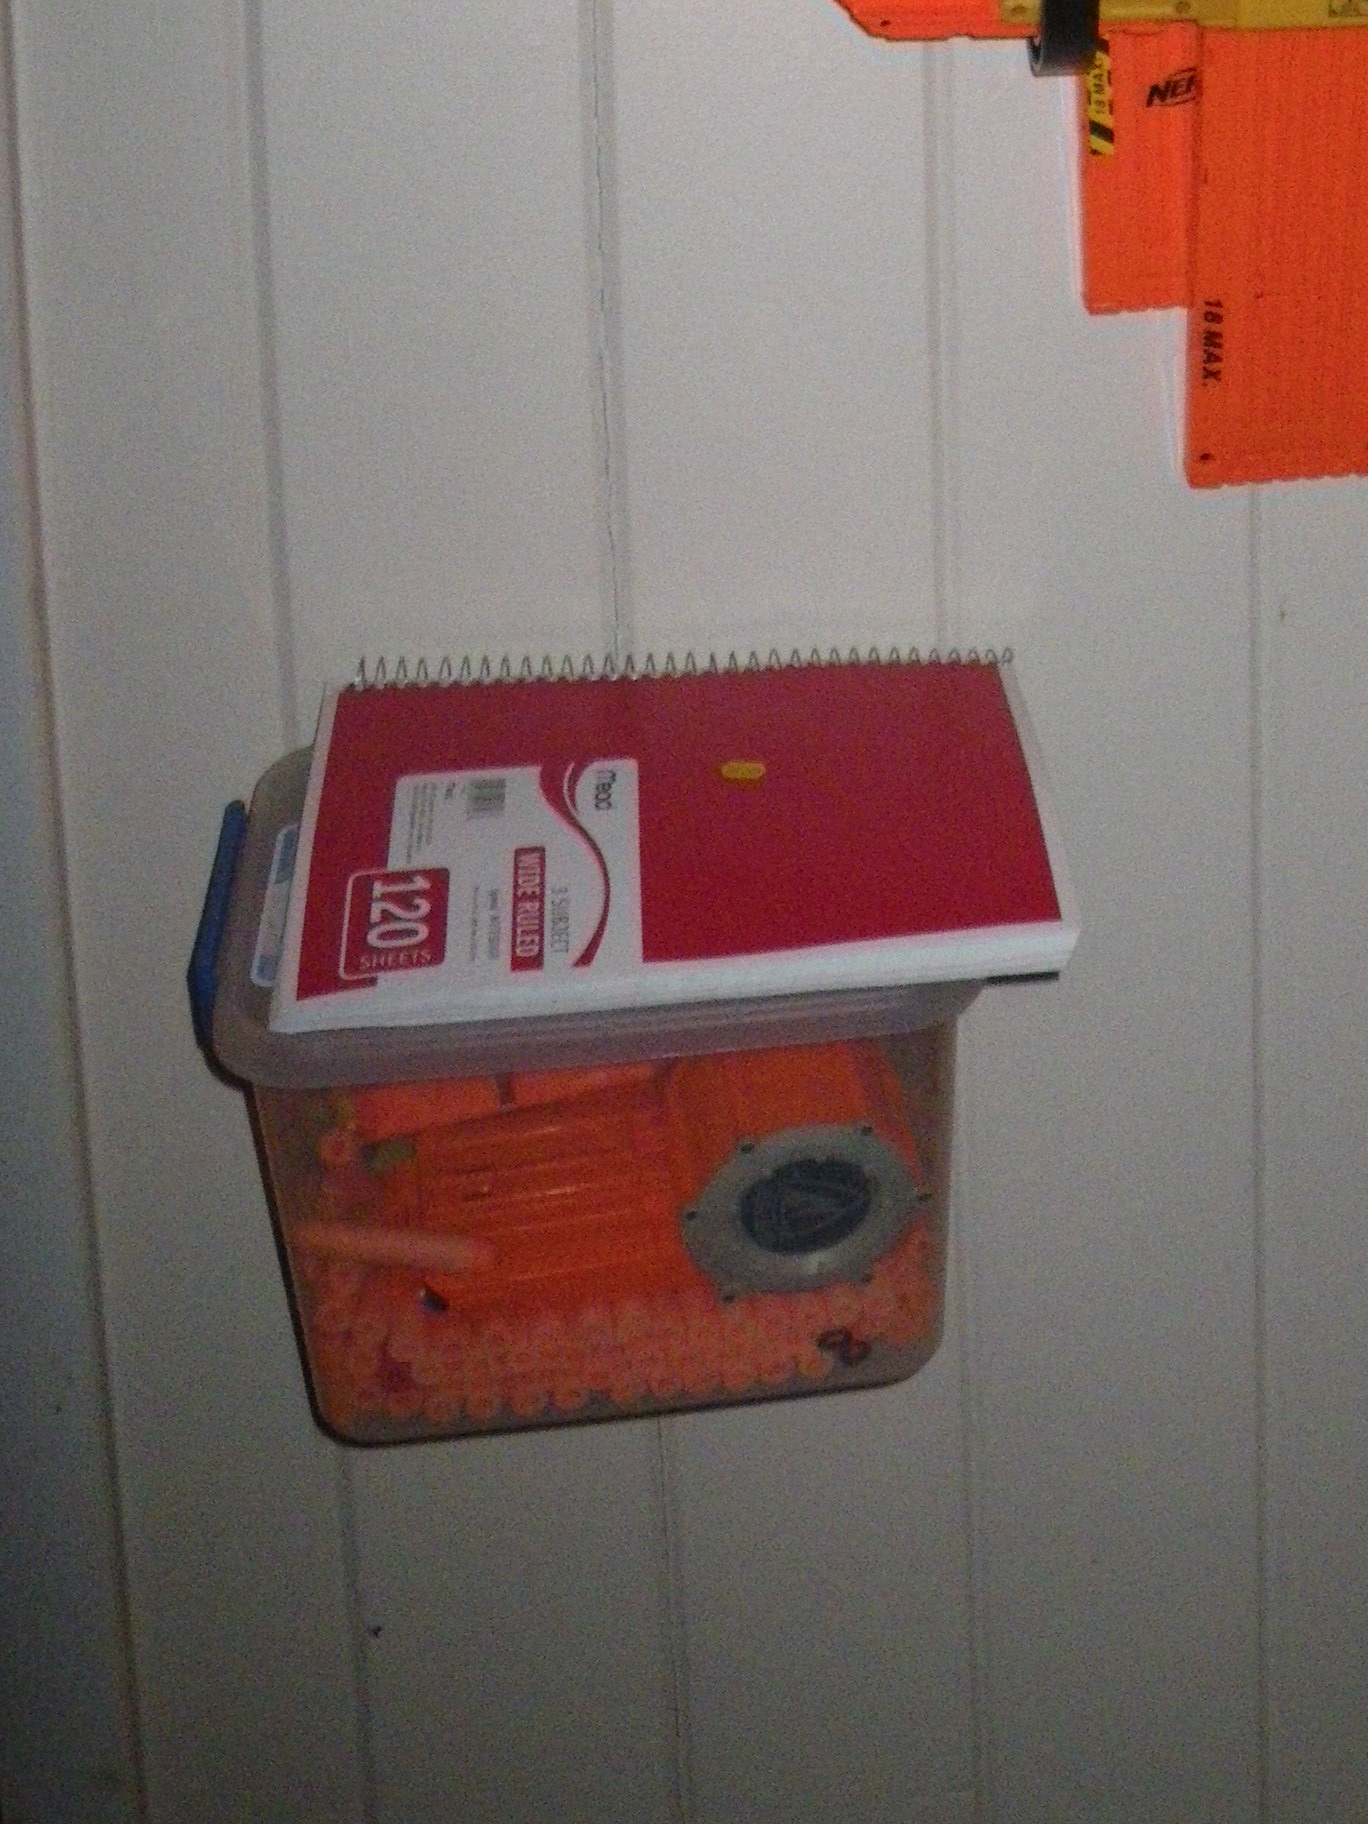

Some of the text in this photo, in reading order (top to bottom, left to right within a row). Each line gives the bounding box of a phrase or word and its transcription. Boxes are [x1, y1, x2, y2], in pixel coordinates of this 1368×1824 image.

[1203, 300, 1223, 325] 18
[366, 875, 432, 949] 120
[514, 852, 542, 957] WIDE RULED
